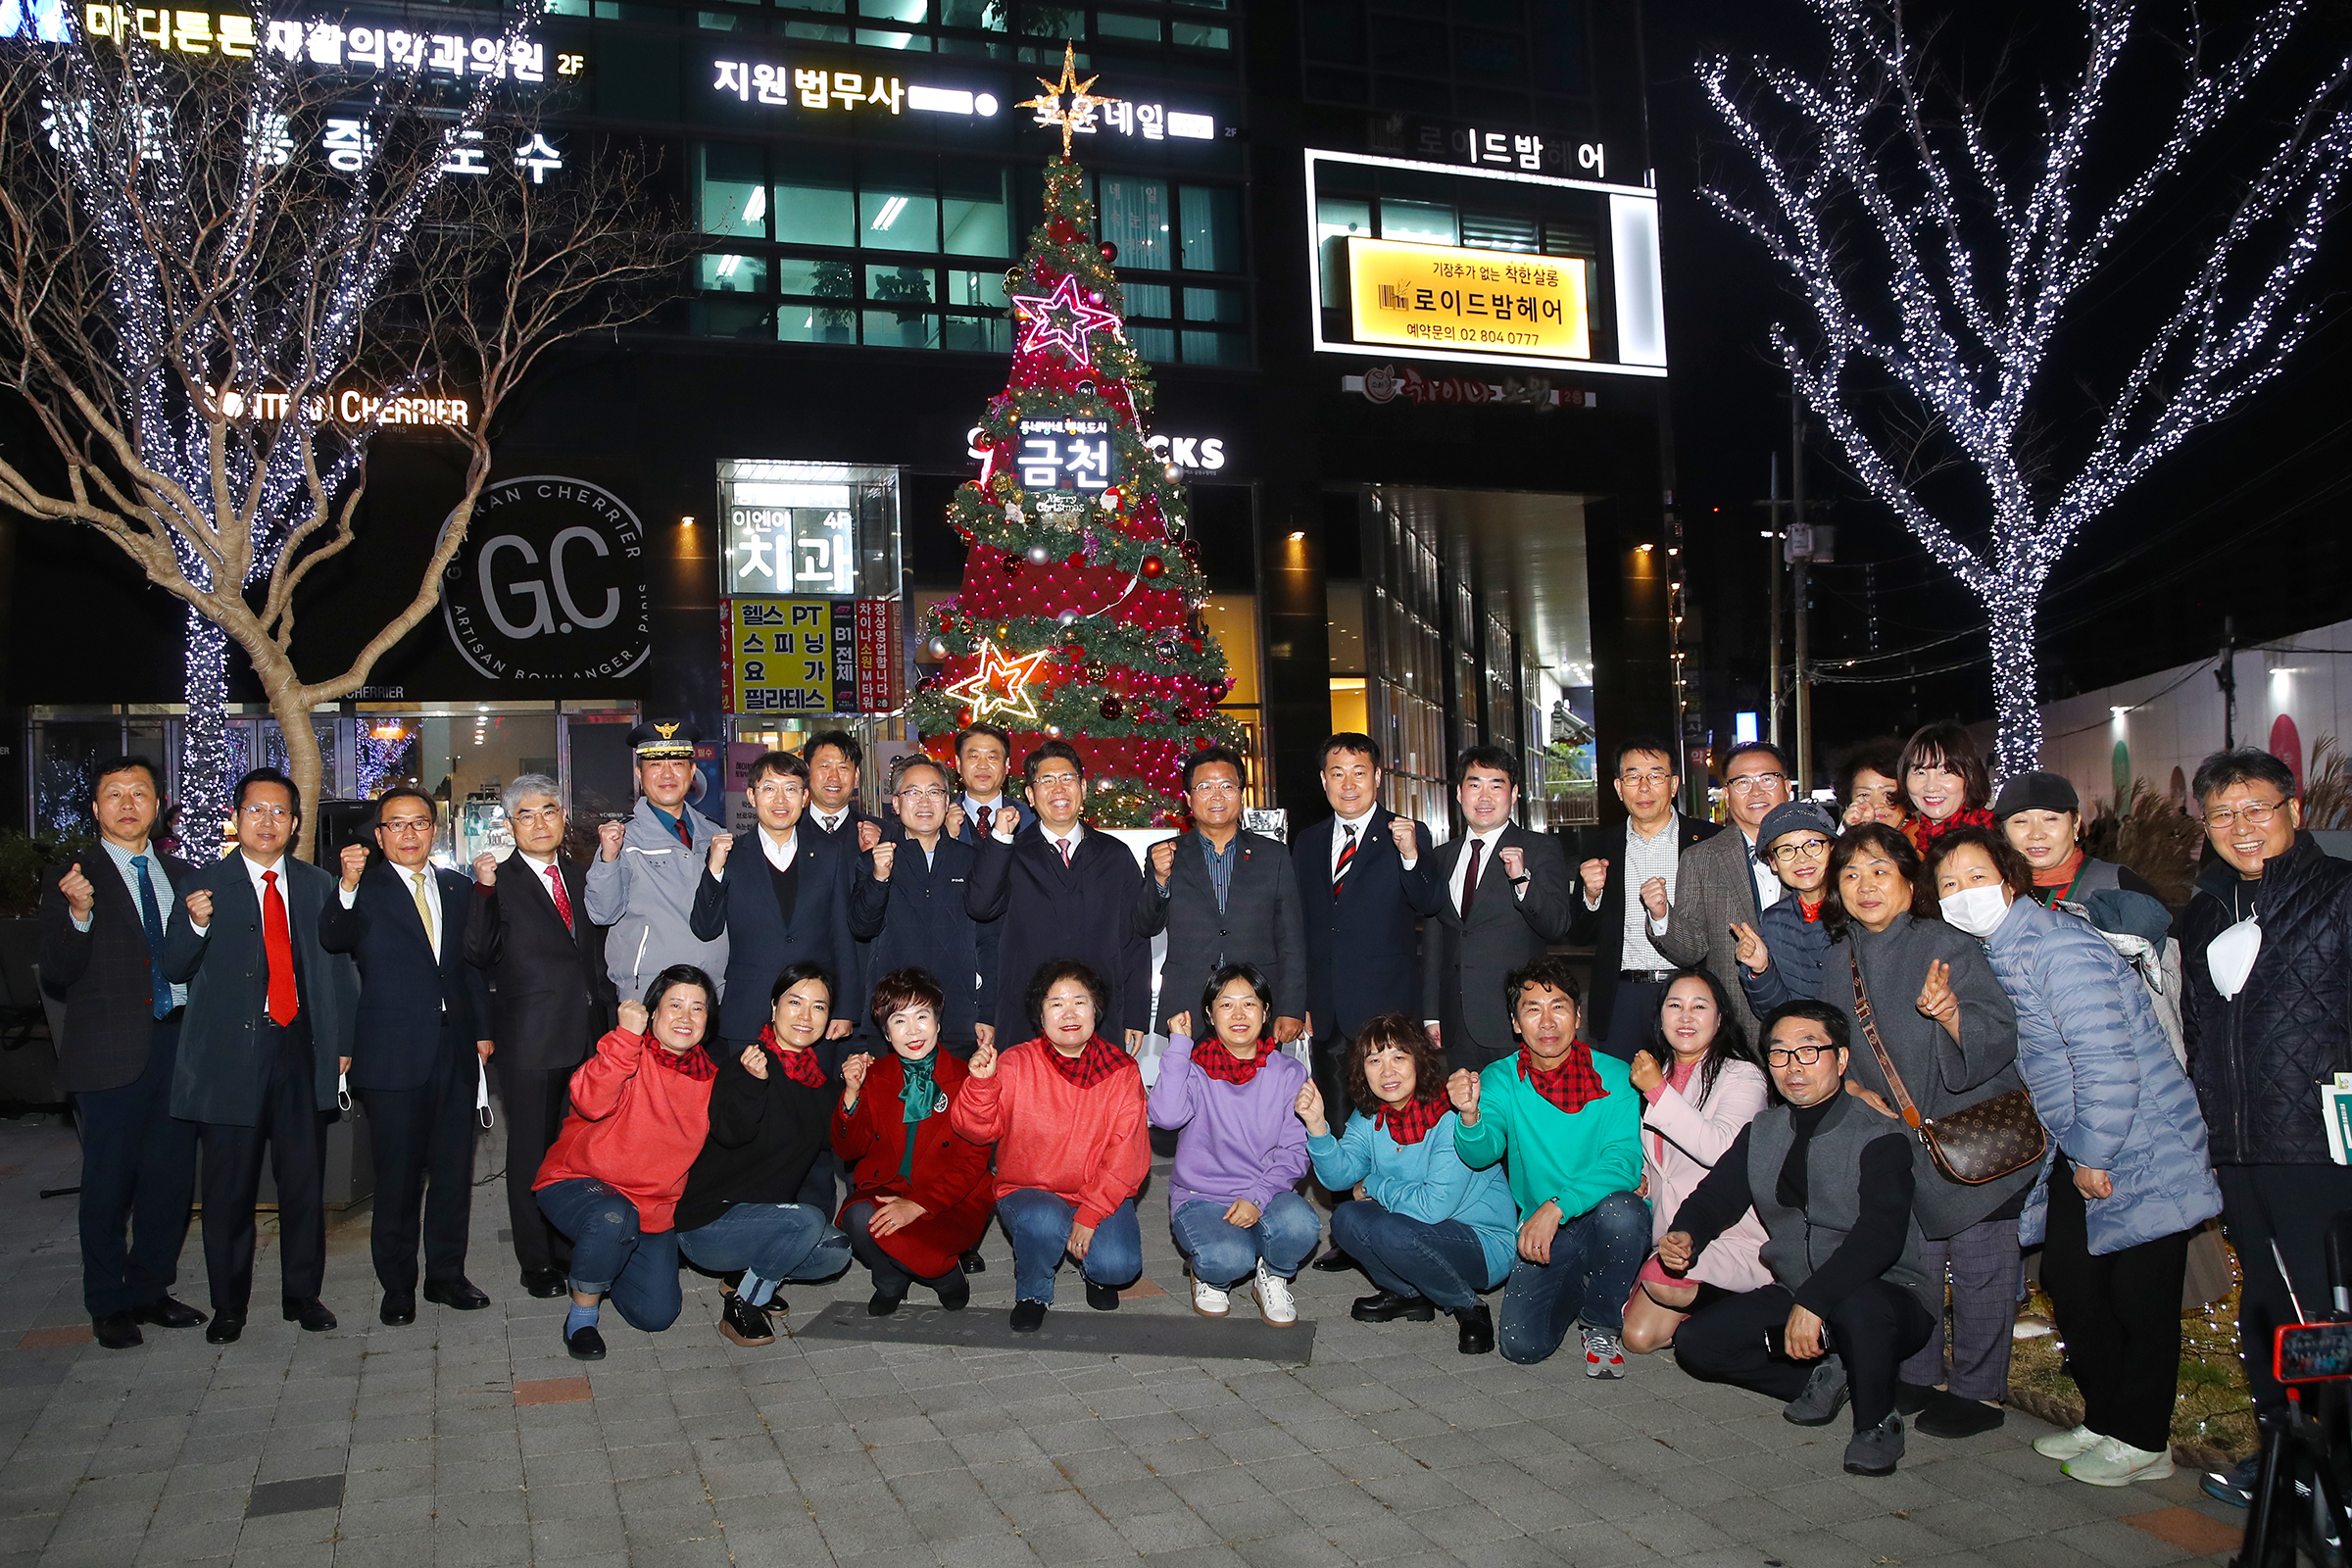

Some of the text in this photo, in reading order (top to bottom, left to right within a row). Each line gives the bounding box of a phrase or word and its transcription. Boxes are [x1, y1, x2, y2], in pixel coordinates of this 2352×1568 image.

[556, 52, 585, 76] 2F
[713, 59, 906, 116] 지원 법무사
[1433, 262, 1559, 288] 기장추가 없는 착한 살롱
[1414, 288, 1563, 325] 로이드밤헤어
[1406, 323, 1456, 341] 예약문의
[1481, 330, 1504, 343] 804
[1507, 332, 1540, 346] 0777
[1017, 438, 1108, 488] 금천
[1046, 493, 1077, 505] Merry
[738, 534, 850, 591] 치과
[742, 604, 823, 625] 헬스 PT
[454, 605, 507, 673] ARTISAN
[835, 627, 852, 642] B1
[874, 603, 888, 696] 정상영업합니다
[744, 688, 826, 710] 필라테스
